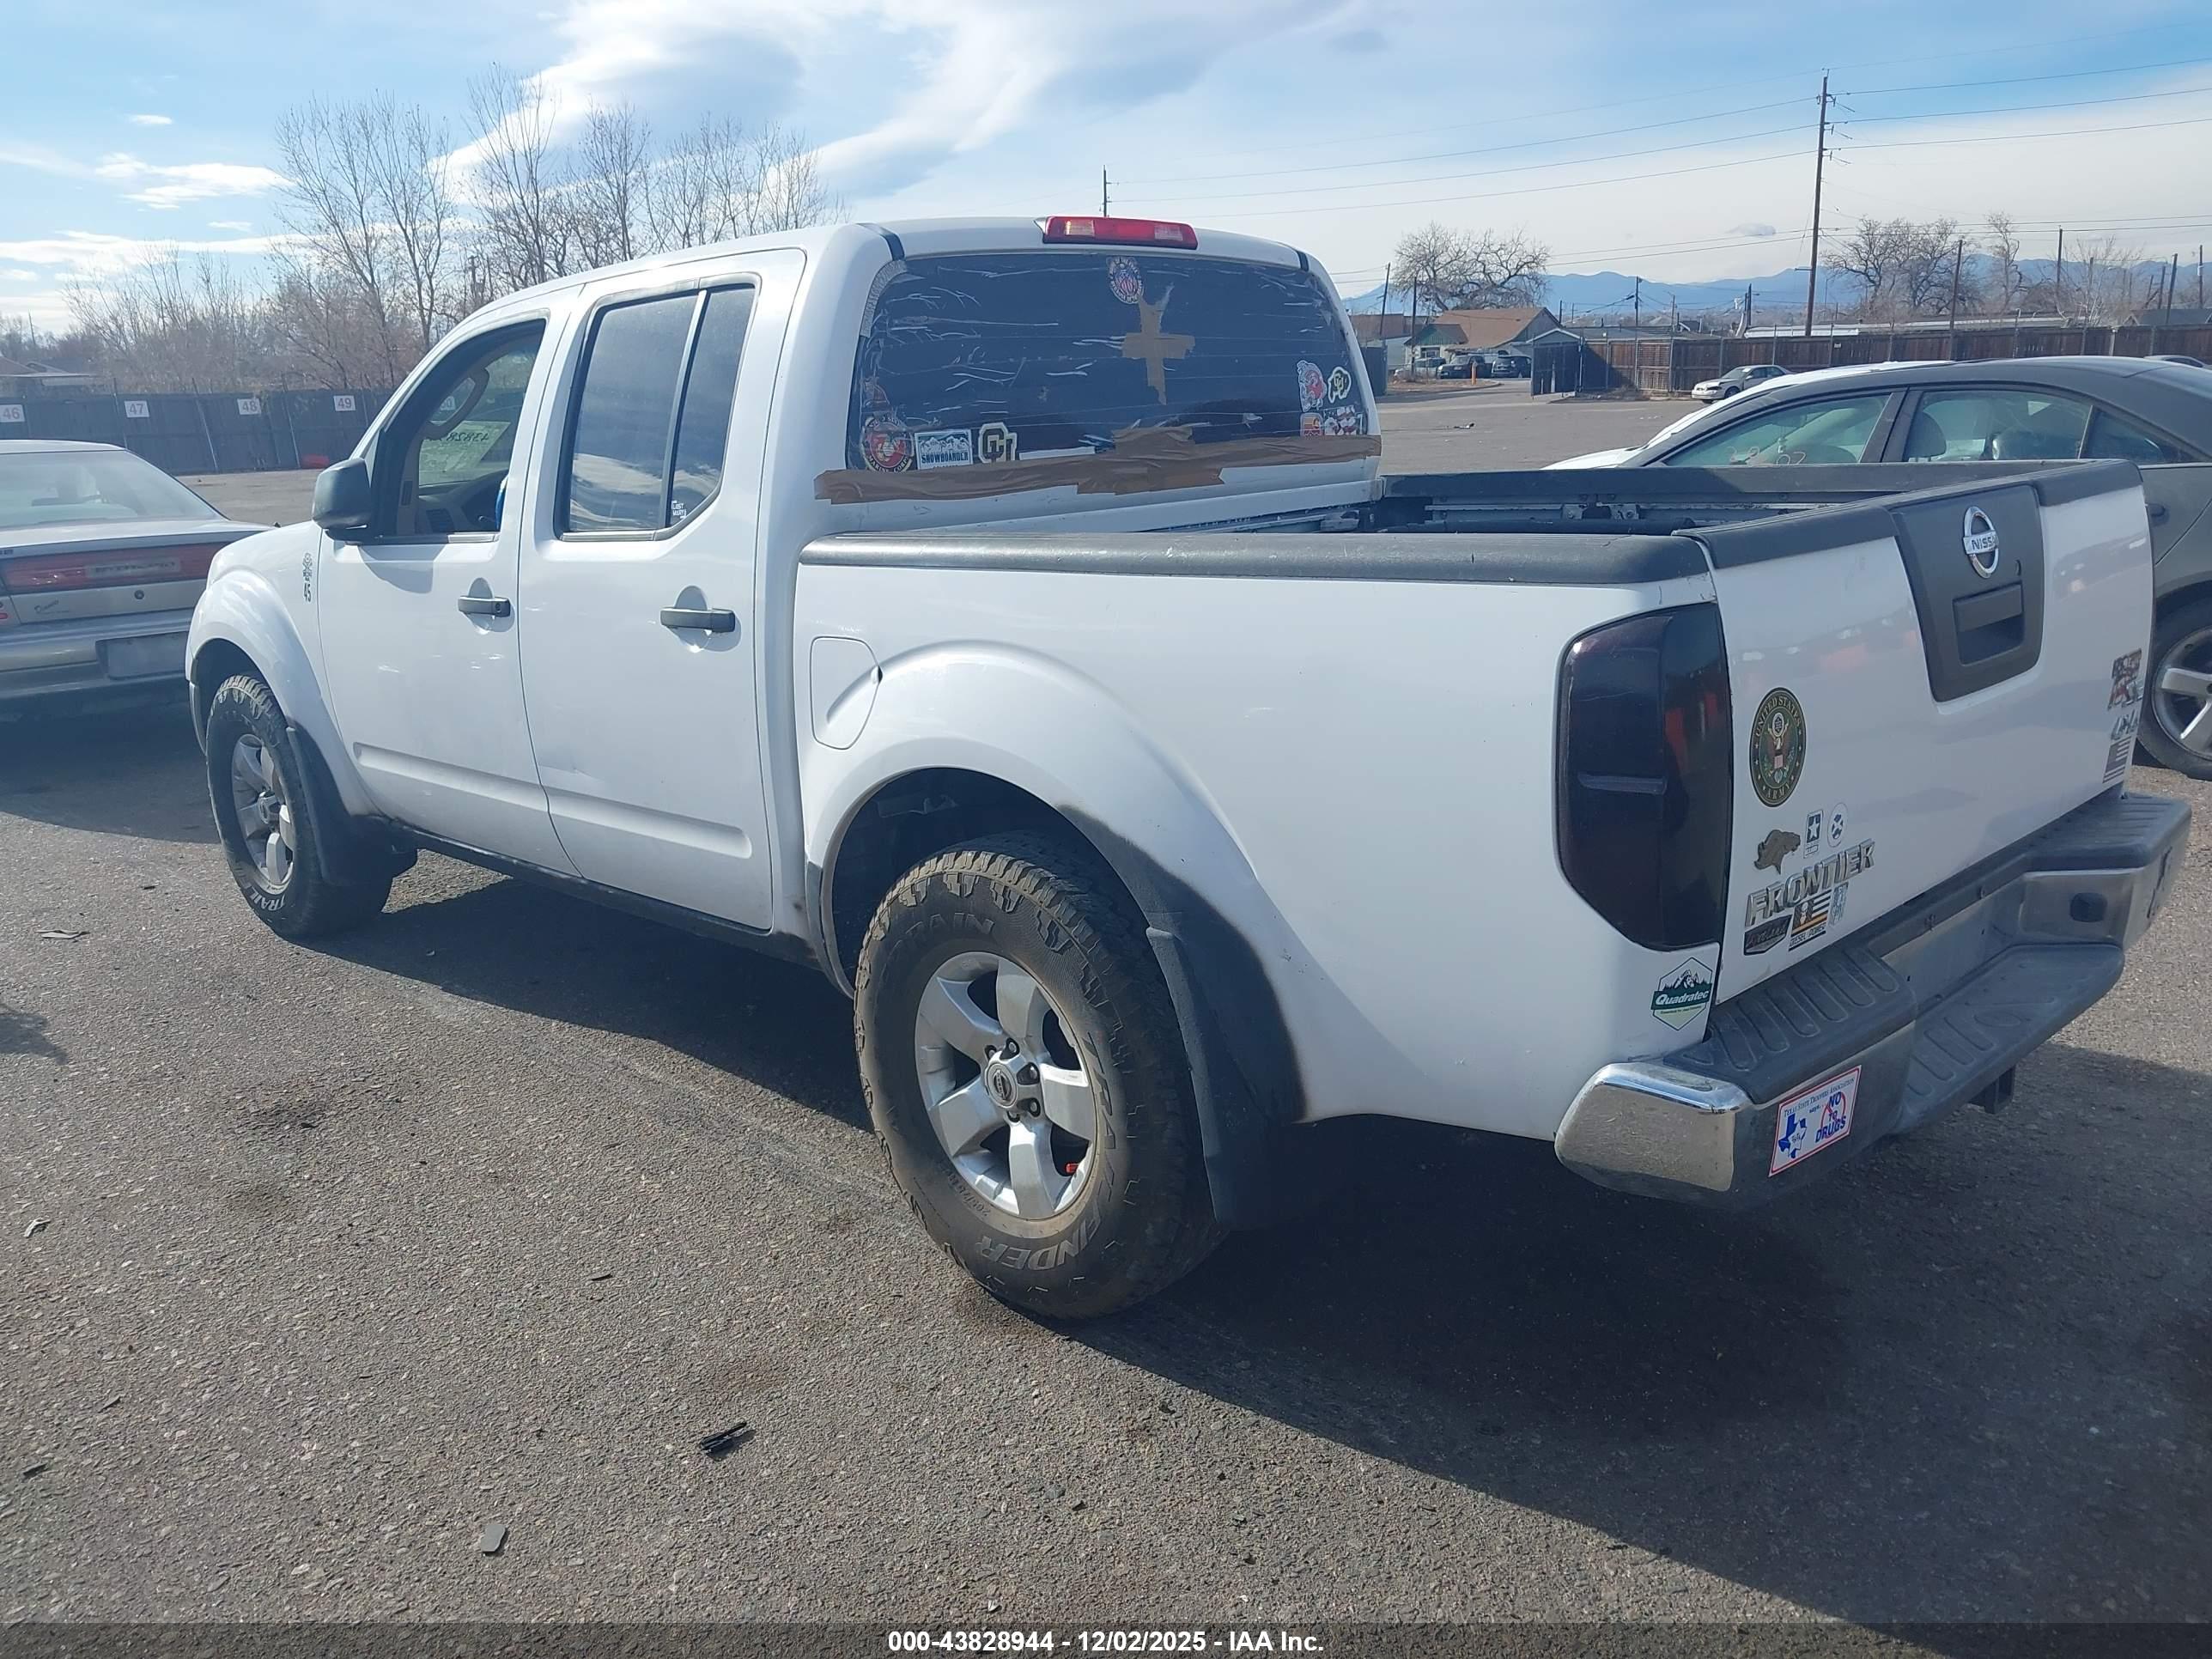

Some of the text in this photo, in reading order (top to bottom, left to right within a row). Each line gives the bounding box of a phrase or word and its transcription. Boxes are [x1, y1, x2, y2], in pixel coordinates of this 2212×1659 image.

[129, 404, 144, 415] 47
[242, 401, 258, 412] 48
[337, 398, 352, 409] 49
[3, 407, 21, 420] 46
[921, 451, 969, 465] SNOWBOARDER
[1972, 536, 1998, 550] NISS
[303, 582, 312, 602] 45
[1755, 695, 1802, 738] UNITED STATES
[1766, 782, 1790, 800] ARMY
[1744, 837, 1875, 928] FRONTIER
[1655, 990, 1709, 1006] Quadratec
[1828, 1091, 1842, 1108] NO
[1814, 1115, 1847, 1144] DRUGS
